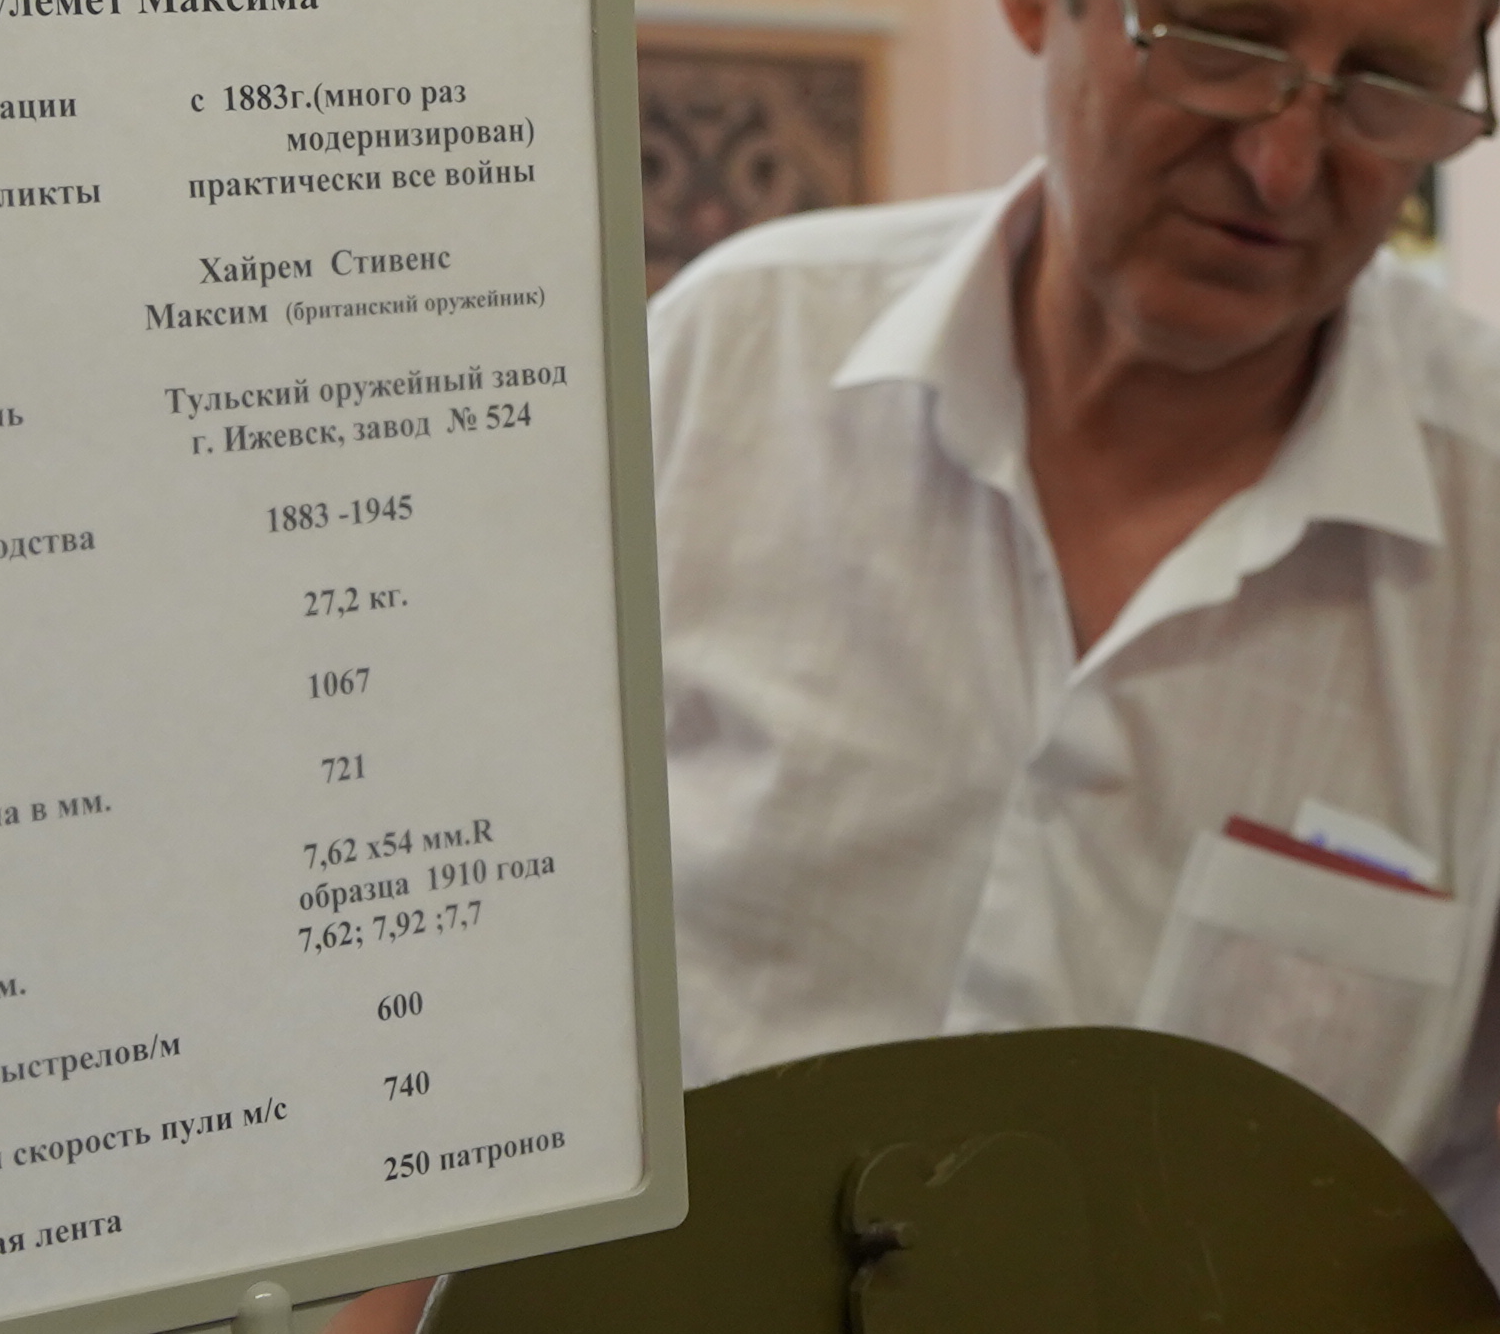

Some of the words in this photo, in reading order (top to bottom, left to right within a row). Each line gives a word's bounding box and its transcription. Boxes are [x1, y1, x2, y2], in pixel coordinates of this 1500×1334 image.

[189, 92, 206, 114] с
[419, 83, 468, 113] раз
[285, 115, 536, 158] модернизирован)
[187, 170, 382, 207] практически
[390, 167, 437, 190] все
[444, 158, 536, 187] войны
[197, 254, 314, 289] Хайрем
[329, 248, 452, 277] Стивенс
[143, 301, 269, 332] Максим
[284, 293, 419, 327] (британский
[423, 285, 546, 317] оружейник)
[163, 377, 311, 422] Тульский
[318, 363, 484, 409] оружейный
[491, 364, 569, 390] завод
[191, 434, 215, 456] г.
[223, 423, 346, 453] Ижевск,
[352, 416, 432, 442] завод
[485, 400, 533, 431] 524
[266, 501, 330, 534] 1883
[303, 585, 361, 619] 27,2
[368, 588, 409, 611] кг.
[308, 666, 371, 700] 1067
[320, 752, 366, 785] 721
[30, 801, 49, 823] в
[57, 793, 112, 819] мм.
[302, 836, 358, 872] 7,62
[298, 876, 411, 915] образца
[427, 858, 488, 892] 1910
[496, 855, 557, 882] года
[297, 919, 365, 956] 7,62;
[371, 908, 427, 944] 7,92
[376, 989, 425, 1023] 600
[382, 1069, 431, 1103] 740
[12, 1126, 152, 1167] скорость
[160, 1110, 234, 1146] пули
[242, 1095, 289, 1128] м/с
[382, 1149, 431, 1183] 250
[438, 1130, 567, 1172] патронов
[34, 1213, 124, 1249] лента
